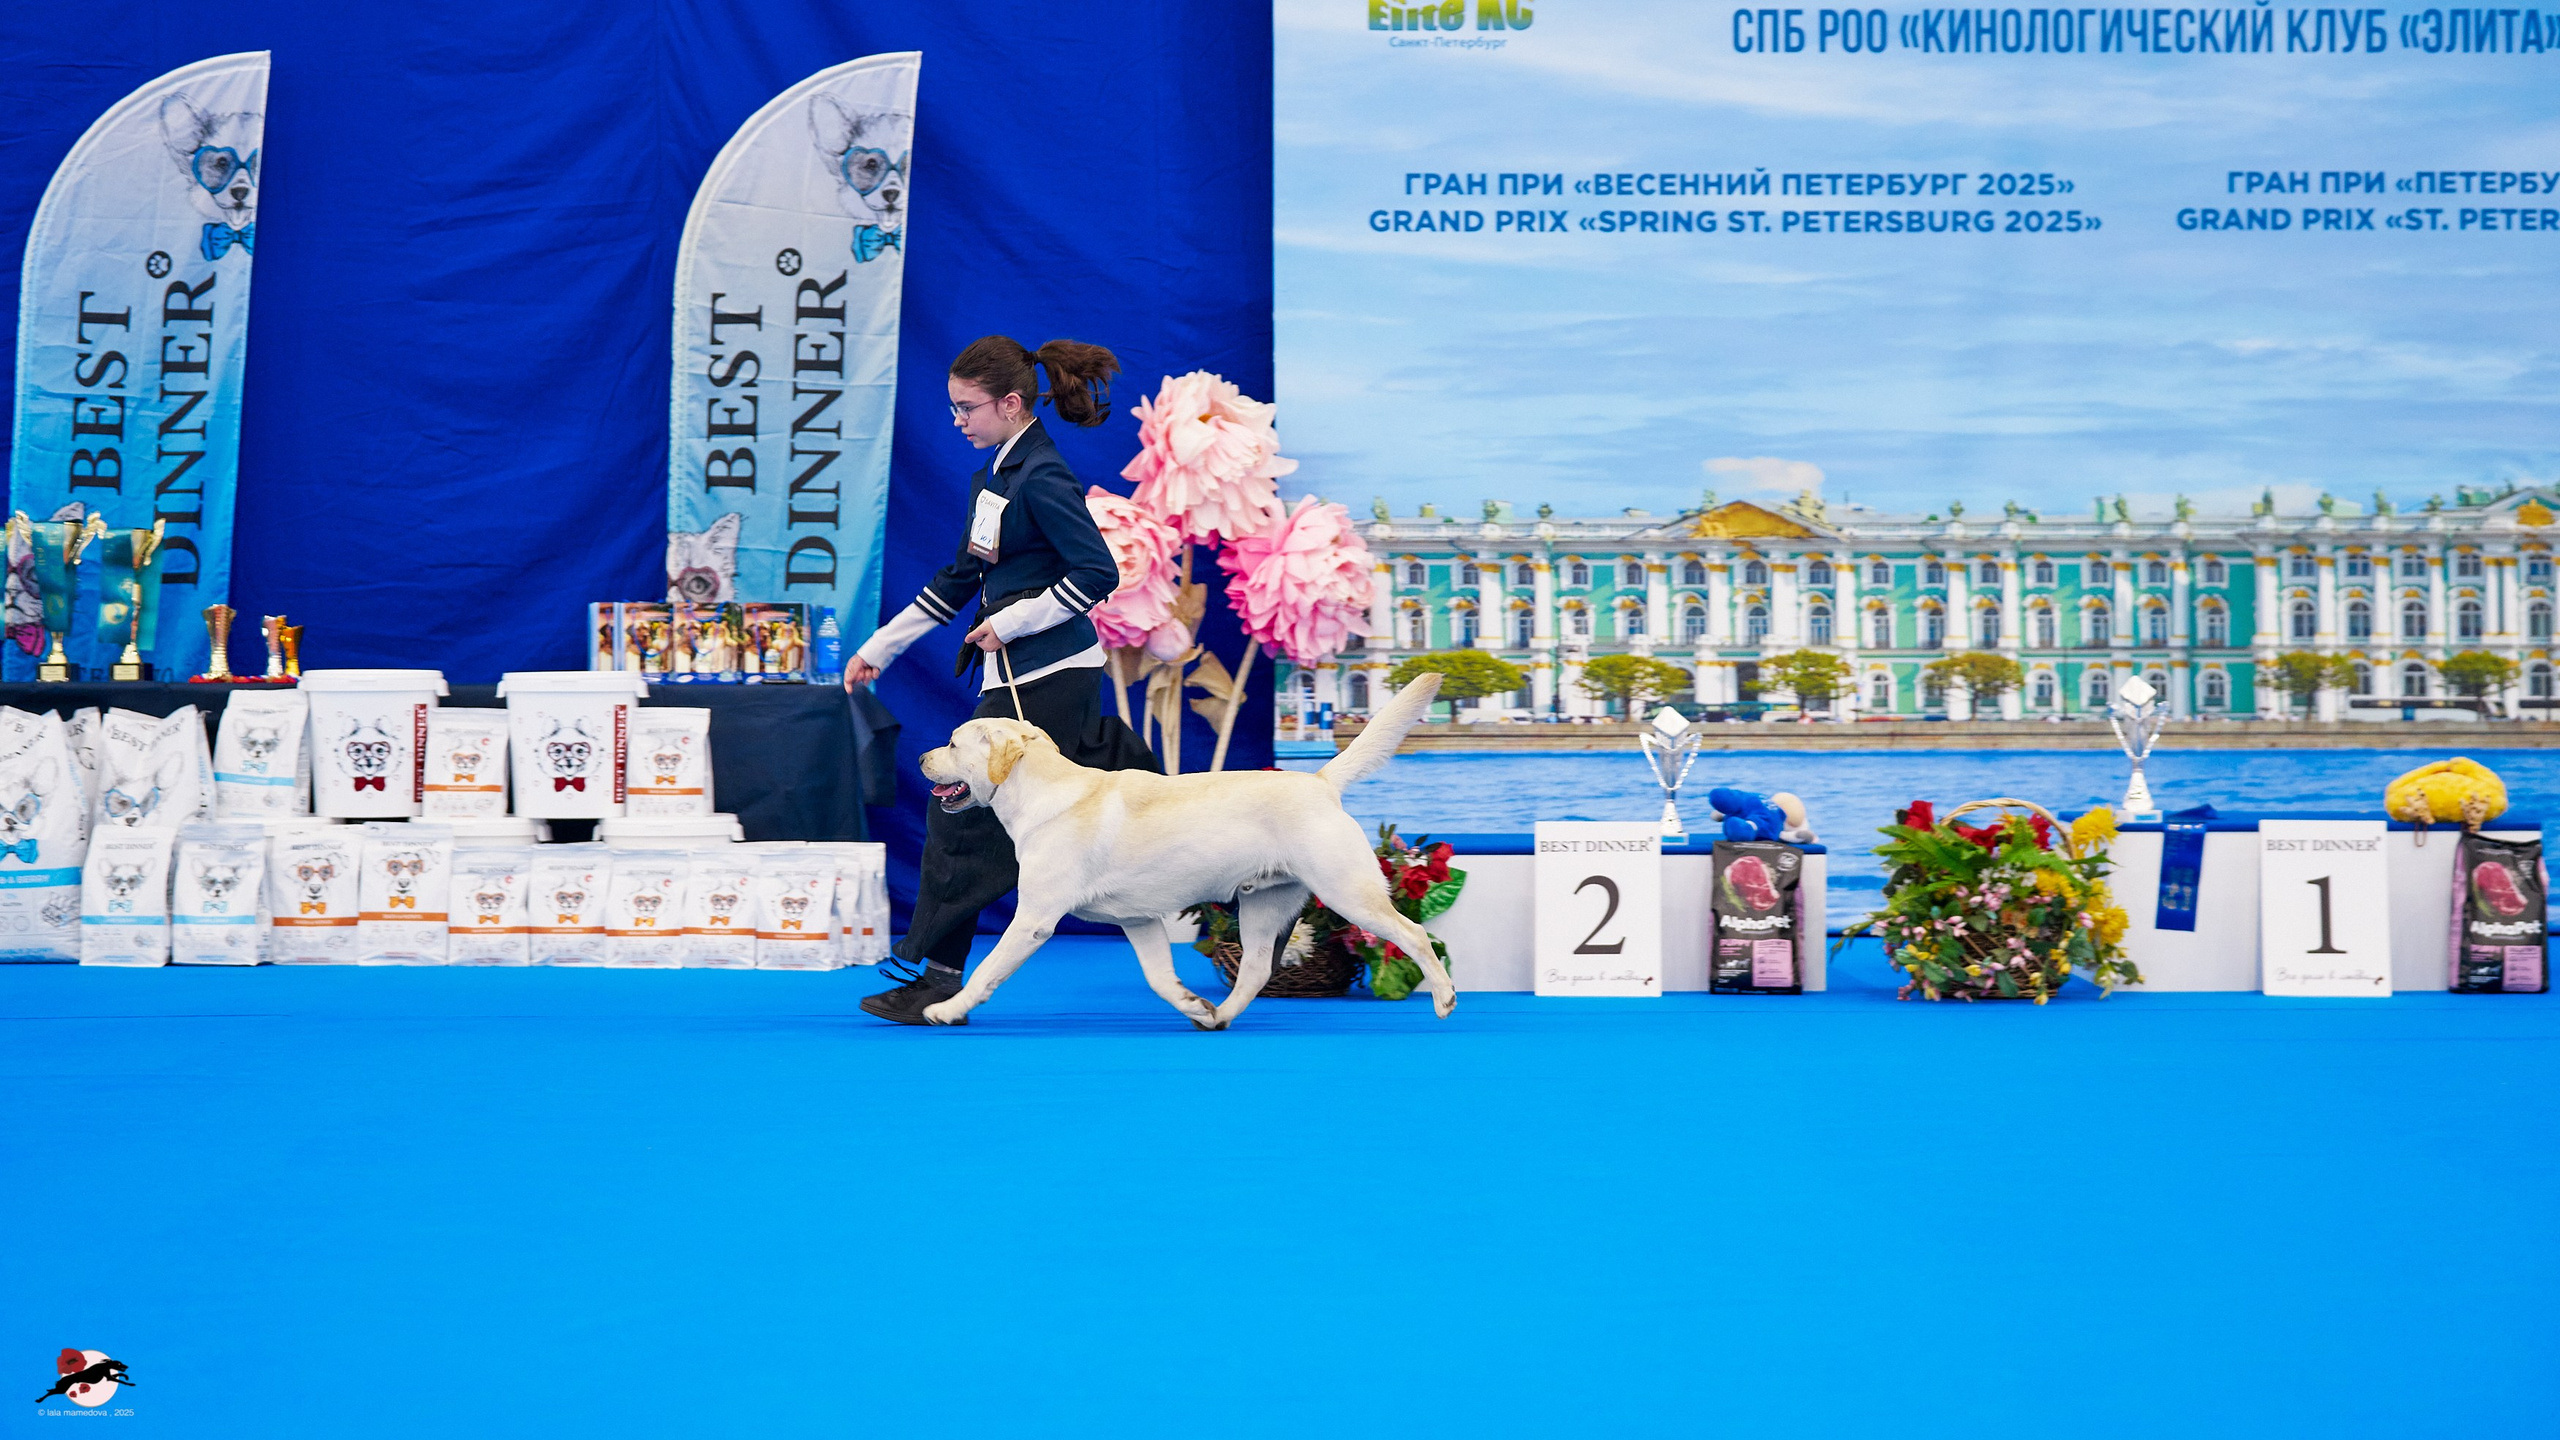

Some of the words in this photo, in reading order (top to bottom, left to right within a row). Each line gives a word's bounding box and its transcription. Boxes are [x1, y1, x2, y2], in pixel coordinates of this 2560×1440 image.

[1388, 36, 1507, 50] Санкт-Петербург
[1733, 9, 1805, 53] СПБ
[1819, 9, 1887, 53] РОО
[1900, 1, 2273, 53] «КИНОЛОГИЧЕСКИЙ
[2287, 9, 2387, 53] КЛУБ
[1405, 173, 1487, 196] ГРАН
[1498, 173, 1563, 196] ПРИ
[1574, 167, 1770, 196] «ВЕСЕННИЙ
[1782, 173, 1968, 196] ПЕТЕРБУРГ
[1977, 173, 2075, 196] 2025»
[2227, 171, 2309, 194] ГРАН
[2320, 171, 2386, 194] ПРИ
[1369, 210, 1484, 233] GRAND
[1496, 210, 1568, 233] PRIX
[1579, 210, 1717, 233] «SPRING
[1727, 210, 1771, 233] ST.
[1781, 210, 1995, 233] PETERSBURG
[2004, 210, 2103, 233] 2025»
[2176, 208, 2292, 231] GRAND
[2302, 208, 2375, 231] PRIX
[2385, 208, 2449, 231] «ST.
[2459, 208, 2560, 231] PETER
[69, 291, 131, 495] BEST
[704, 292, 763, 496] BEST
[154, 271, 216, 591] DINNER
[784, 269, 848, 592] DINNER
[416, 709, 427, 763] DINNER
[615, 710, 627, 763] DINNER
[615, 766, 626, 802] BEST
[1540, 841, 1581, 852] BEST
[1586, 841, 1651, 852] DINNER
[2266, 839, 2308, 851] BEST
[2312, 839, 2378, 851] DINNER
[1573, 875, 1626, 955] 2
[1719, 915, 1793, 931] AlphaPet
[2306, 875, 2348, 954] 1
[2470, 920, 2543, 937] AlphaPet
